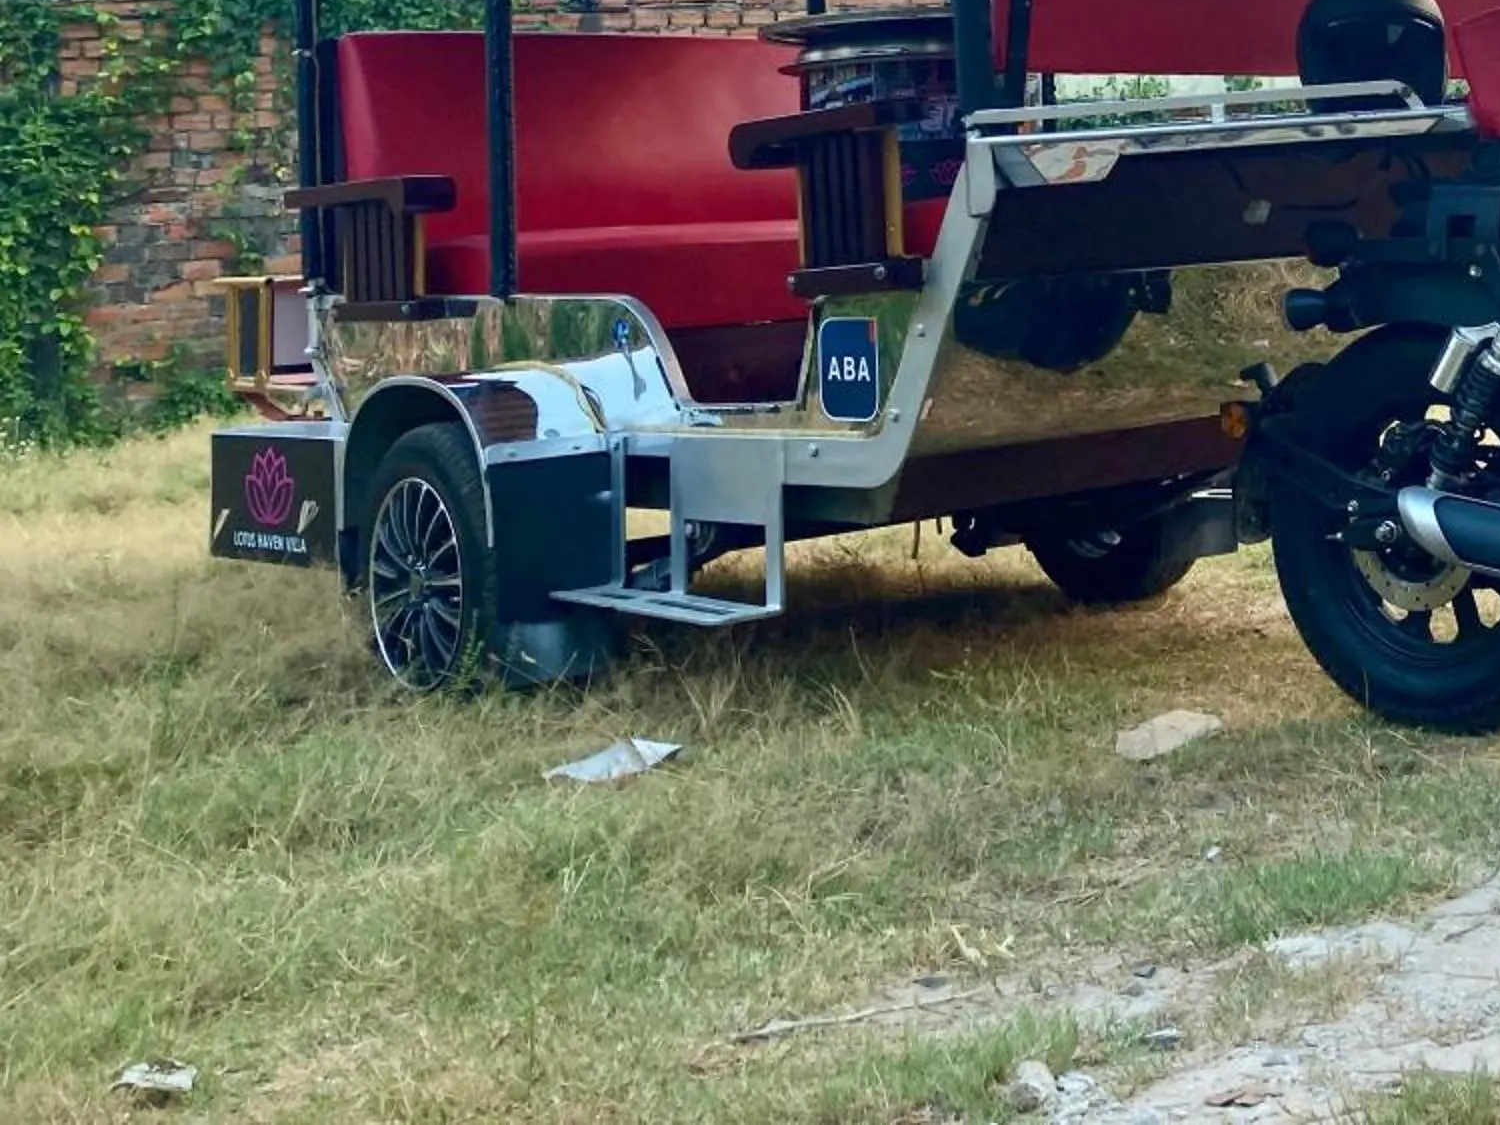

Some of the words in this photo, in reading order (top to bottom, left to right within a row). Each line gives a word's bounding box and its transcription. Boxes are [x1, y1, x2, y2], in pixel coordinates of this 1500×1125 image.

[827, 356, 871, 382] ABA
[233, 530, 256, 548] LOTUS
[257, 532, 284, 552] HAVEN
